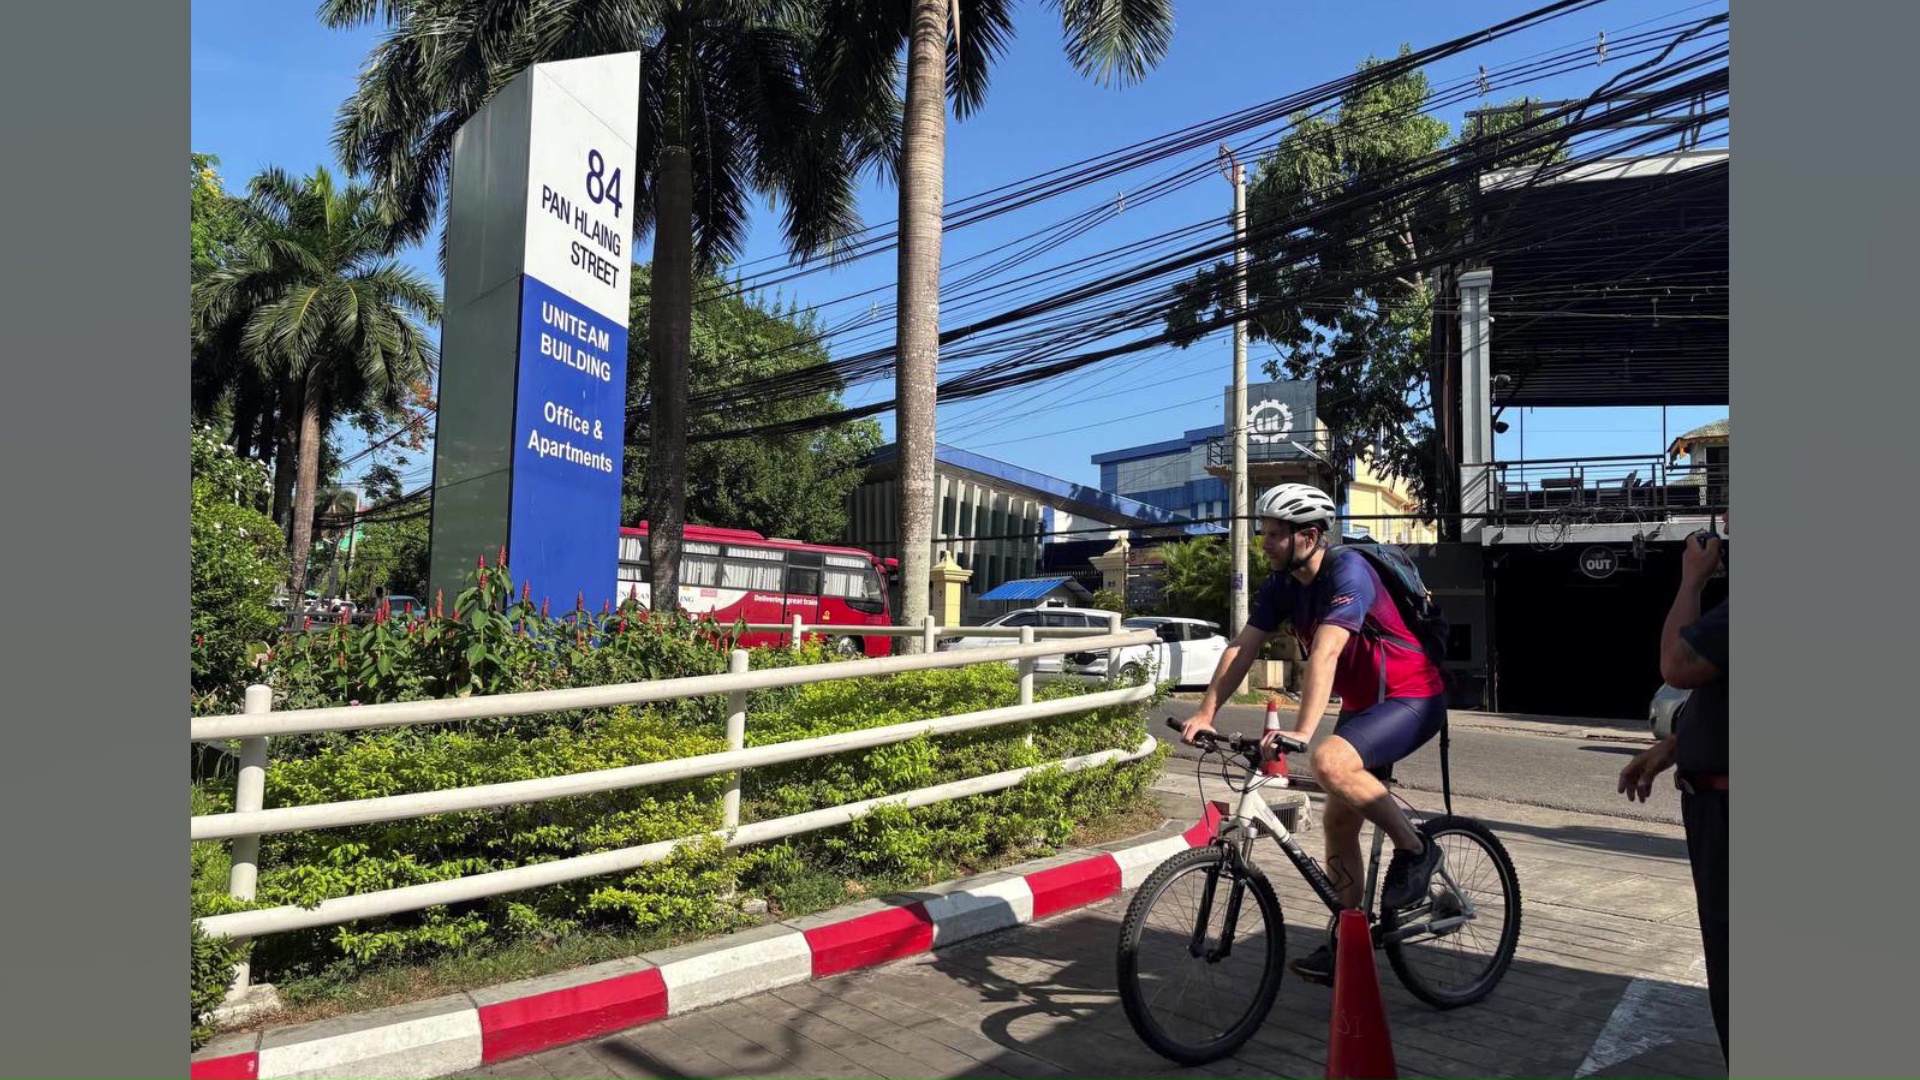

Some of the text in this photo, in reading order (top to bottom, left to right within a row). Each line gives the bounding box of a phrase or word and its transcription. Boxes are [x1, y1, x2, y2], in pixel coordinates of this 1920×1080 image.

[586, 149, 622, 218] 84
[542, 184, 621, 257] PAN HLAING
[571, 240, 619, 289] STREET
[542, 301, 610, 352] UNITEAM
[540, 333, 611, 382] BUILDING
[544, 401, 603, 440] Office &
[527, 429, 613, 473] Apartments
[1586, 559, 1612, 570] OUT
[786, 597, 803, 606] great
